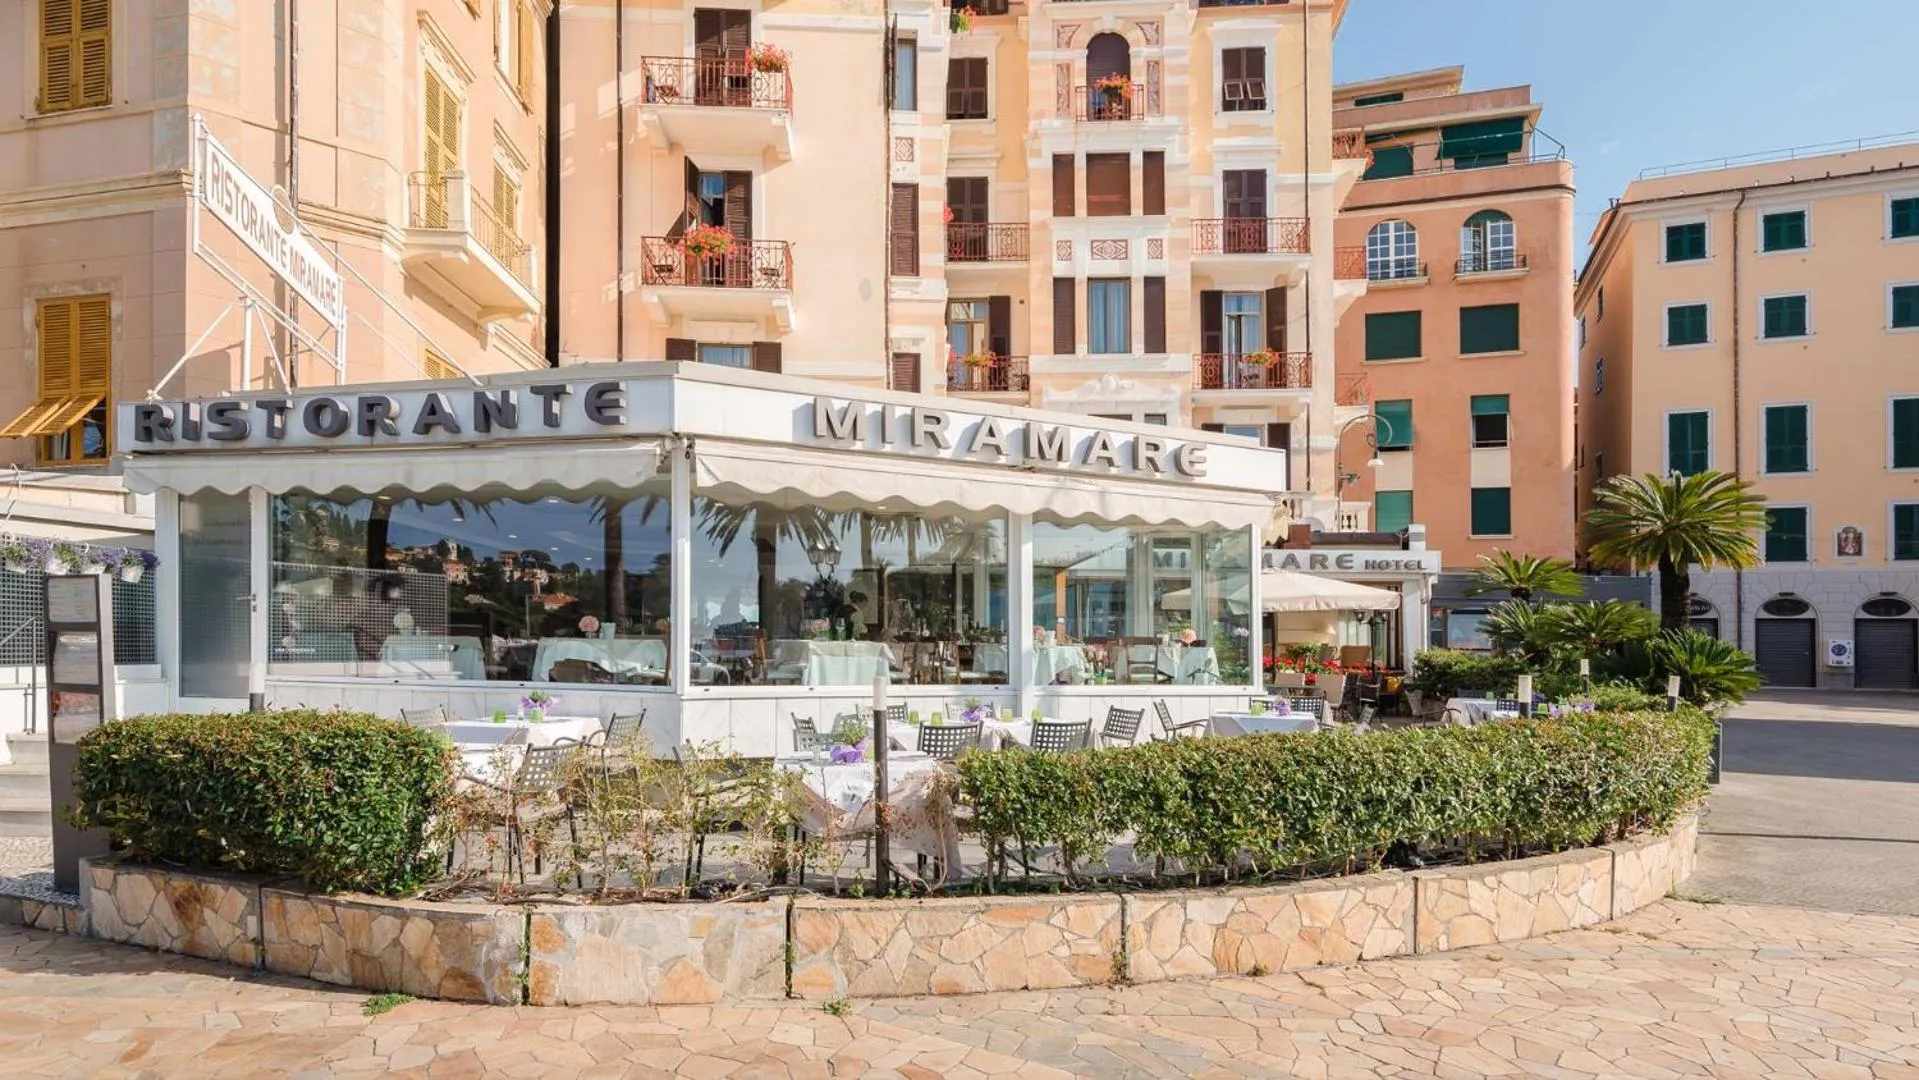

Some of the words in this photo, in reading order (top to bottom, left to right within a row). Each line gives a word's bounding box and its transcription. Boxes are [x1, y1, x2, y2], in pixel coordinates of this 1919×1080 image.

[211, 151, 288, 269] RISTORANTE
[289, 246, 337, 317] MIRAMARE
[134, 381, 628, 443] RISTORANTE
[813, 396, 1208, 477] MIRAMARE
[1364, 559, 1428, 571] HOTEL
